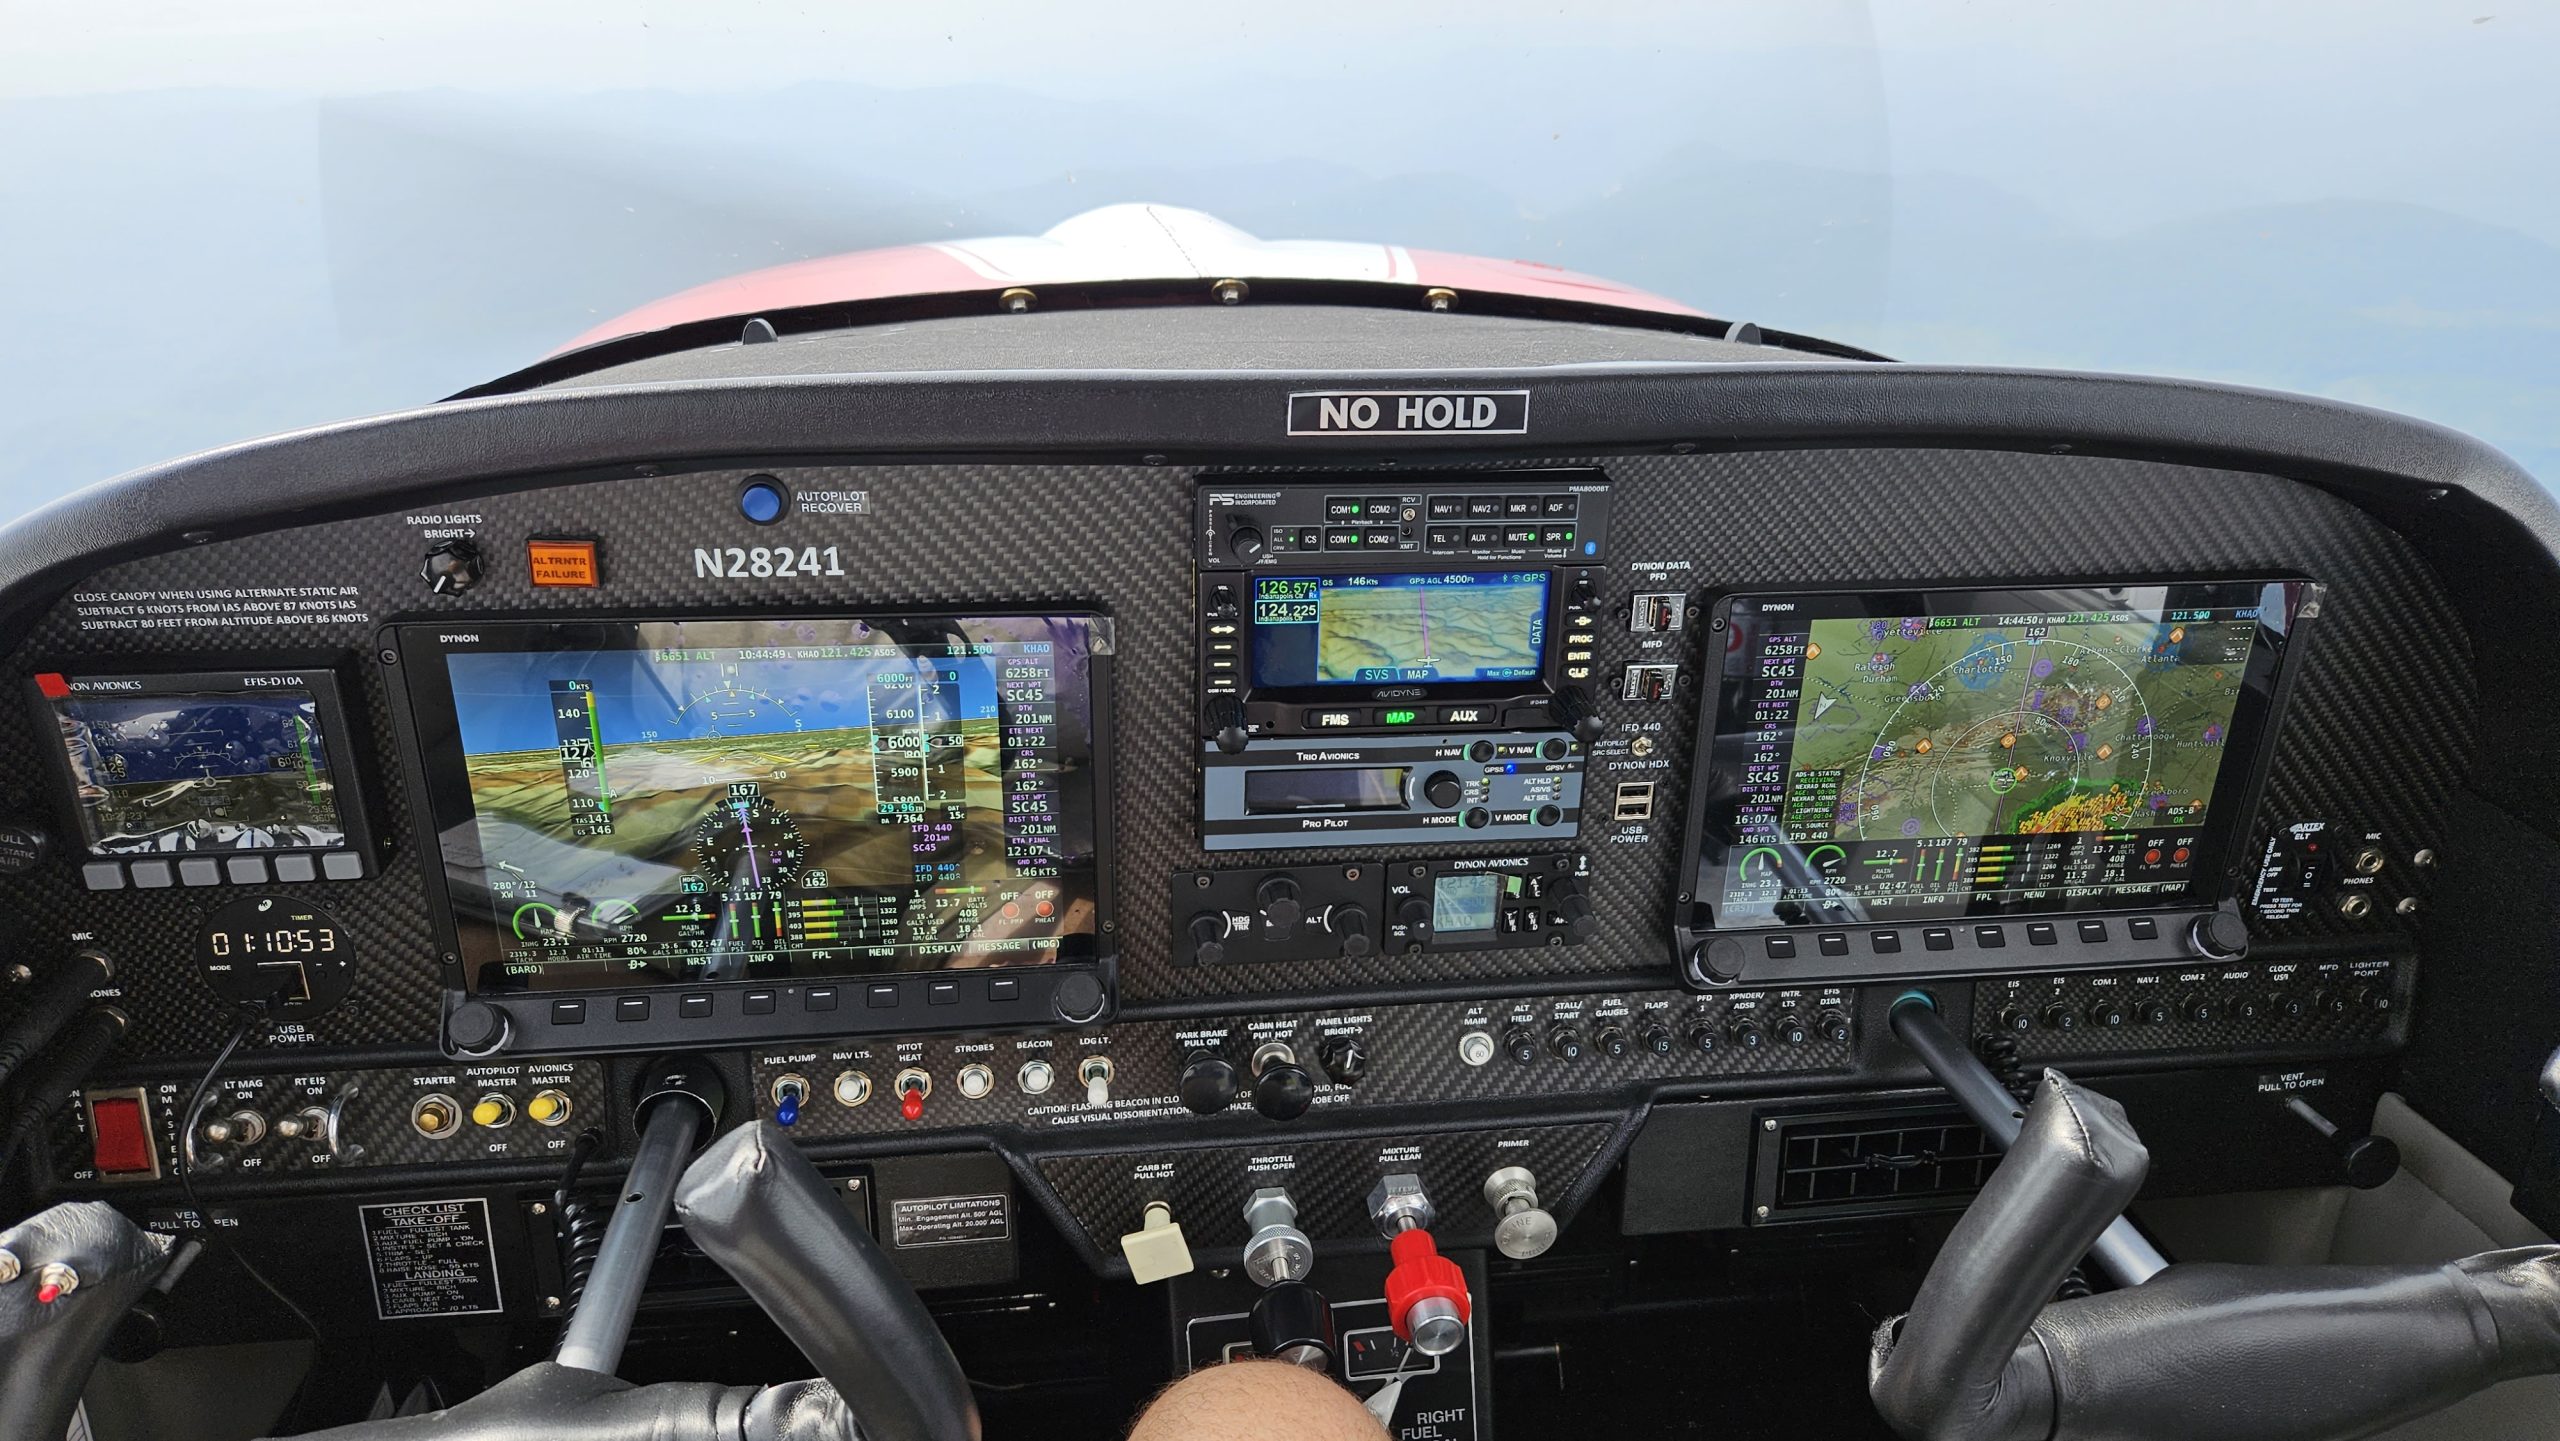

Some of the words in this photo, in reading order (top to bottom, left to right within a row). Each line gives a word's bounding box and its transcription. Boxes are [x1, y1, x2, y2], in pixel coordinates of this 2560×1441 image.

[1319, 398, 1379, 429] NO
[1398, 398, 1497, 428] HOLD
[797, 491, 867, 502] AUTOPILOT
[801, 502, 862, 513] RECOVER
[1331, 506, 1350, 514] COM1
[1370, 505, 1390, 513] COM2
[1435, 505, 1452, 513] NAV1
[1473, 505, 1491, 513] NAV2
[1510, 504, 1526, 512] MKR
[407, 515, 442, 525] RADIO
[445, 514, 482, 525] LIGHTS
[1330, 535, 1350, 543] COM1
[1369, 535, 1389, 543] COM2
[1509, 533, 1527, 541] MUTE
[533, 557, 586, 566] ALTRNTR
[695, 546, 844, 578] N28241
[1632, 562, 1664, 571] DYNON
[1667, 561, 1690, 570] DATA
[536, 570, 585, 580] FAILURE
[1523, 573, 1546, 583] GPS
[1259, 581, 1316, 595] 126.575
[74, 593, 108, 602] CLOSE
[111, 592, 156, 601] CANOPY
[158, 590, 194, 600] WHEN
[197, 589, 232, 599] USING
[235, 588, 297, 598] ALTERNATE
[300, 587, 337, 596] STATIC
[339, 586, 358, 595] AIR
[78, 606, 134, 616] SUBTRACT
[137, 606, 144, 614] 6
[146, 604, 184, 614] KNOTS
[187, 603, 220, 612] FROM
[223, 602, 240, 612] IAS
[244, 602, 281, 611] ABOVE
[284, 601, 296, 610] 87
[300, 600, 336, 610] KNOTS
[338, 600, 356, 609] IAS
[1259, 603, 1316, 618] 124.225
[82, 620, 138, 630] SUBTRACT
[141, 619, 154, 628] 80
[157, 618, 182, 628] FEET
[185, 617, 218, 627] FROM
[221, 616, 274, 626] ALTITUDE
[276, 615, 314, 624] ABOVE
[316, 614, 330, 624] 86
[332, 613, 368, 622] KNOTS
[440, 634, 479, 643] DYNON
[1569, 634, 1593, 645] PROC
[1642, 640, 1662, 648] MFD
[821, 648, 871, 657] 121.425
[947, 645, 992, 654] 121.500
[1568, 651, 1591, 661] ENTR
[1568, 667, 1588, 677] CLR
[1762, 666, 1794, 677] SC45
[1854, 663, 1895, 673] Raleigh
[1365, 669, 1389, 680] SVS
[1408, 670, 1428, 679] MAP
[93, 680, 142, 690] AVIONICS
[244, 677, 303, 686] EFIS-D10A
[1007, 690, 1043, 701] SC45
[1376, 689, 1422, 697] AVIDYNE
[558, 709, 580, 718] 140
[886, 709, 914, 718] 6100
[1387, 711, 1415, 724] MAP
[1450, 709, 1478, 722] AUX
[1322, 713, 1349, 726] FMS
[1622, 724, 1639, 732] IFD
[1008, 736, 1045, 747] 01:22
[1608, 761, 1646, 770] DYNON
[1649, 760, 1670, 768] HDX
[568, 769, 589, 778] 120
[891, 768, 918, 777] 5900
[731, 785, 755, 796] 167
[912, 824, 931, 832] IFD
[935, 823, 952, 832] 440
[1622, 826, 1642, 834] USB
[1610, 835, 1648, 843] POWER
[1454, 859, 1485, 870] DYNON
[1488, 858, 1528, 867] AVIONICS
[1392, 886, 1410, 894] VOL
[2066, 888, 2102, 896] DISPLAY
[1923, 896, 1944, 904] INFO
[1976, 893, 1992, 901] FPL
[1871, 898, 1893, 906] NRST
[1306, 916, 1322, 924] ALT
[72, 932, 93, 941] MIC
[869, 948, 894, 956] MENU
[920, 944, 962, 954] DISPLAY
[748, 954, 774, 962] INFO
[812, 951, 832, 959] FPL
[687, 956, 713, 965] NRST
[2350, 961, 2389, 969] LIGHTER
[1602, 998, 1622, 1007] FUEL
[1645, 1001, 1668, 1010] FLAPS
[1467, 1007, 1482, 1015] ALT
[1596, 1007, 1628, 1017] GAUGES
[1316, 1018, 1341, 1026] PANEL
[1344, 1015, 1372, 1025] LIGHTS
[1464, 1017, 1487, 1026] MAIN
[1511, 1013, 1533, 1023] FIELD
[1248, 1022, 1273, 1030] CABIN
[1276, 1021, 1297, 1029] HEAT
[269, 1034, 314, 1043] POWER
[1176, 1032, 1197, 1040] PARK
[1200, 1030, 1228, 1039] BRAKE
[897, 1043, 922, 1051] PITOT
[955, 1044, 994, 1053] STROBES
[1017, 1041, 1052, 1049] BEACON
[764, 1056, 785, 1065] FUEL
[787, 1054, 816, 1063] PUMP
[466, 1066, 520, 1076] AUTOPILOT
[528, 1064, 573, 1073] AVIONICS
[413, 1076, 455, 1085] STARTER
[532, 1076, 570, 1084] MASTER
[2281, 1073, 2304, 1082] VENT
[224, 1081, 236, 1089] LT
[239, 1080, 263, 1088] MAG
[477, 1078, 517, 1087] MASTER
[2259, 1084, 2281, 1092] PULL
[2284, 1082, 2296, 1090] TO
[2299, 1079, 2324, 1088] OPEN
[237, 1091, 252, 1099] ON
[1052, 1116, 1079, 1125] CAUSE
[1082, 1112, 1111, 1122] VISUAL
[489, 1143, 507, 1152] OFF
[548, 1140, 566, 1149] OFF
[1498, 1139, 1529, 1148] PRIMER
[1383, 1146, 1420, 1156] MIXTURE
[1251, 1155, 1293, 1165] THROTTLE
[1379, 1154, 1399, 1163] PULL
[1400, 1152, 1421, 1161] LEAN
[243, 1158, 262, 1167] OFF
[1248, 1163, 1268, 1172] PUSH
[1271, 1162, 1295, 1170] OPEN
[383, 1206, 429, 1216] CHECK
[437, 1204, 464, 1213] LIST
[901, 1203, 947, 1212] AUTOPILOT
[950, 1200, 1000, 1209] LIMITATIONS
[392, 1215, 460, 1226] TAKE-OFF
[405, 1269, 465, 1280] LANDING
[1417, 1409, 1465, 1423] RIGHT
[1402, 1426, 1442, 1440] FUEL
